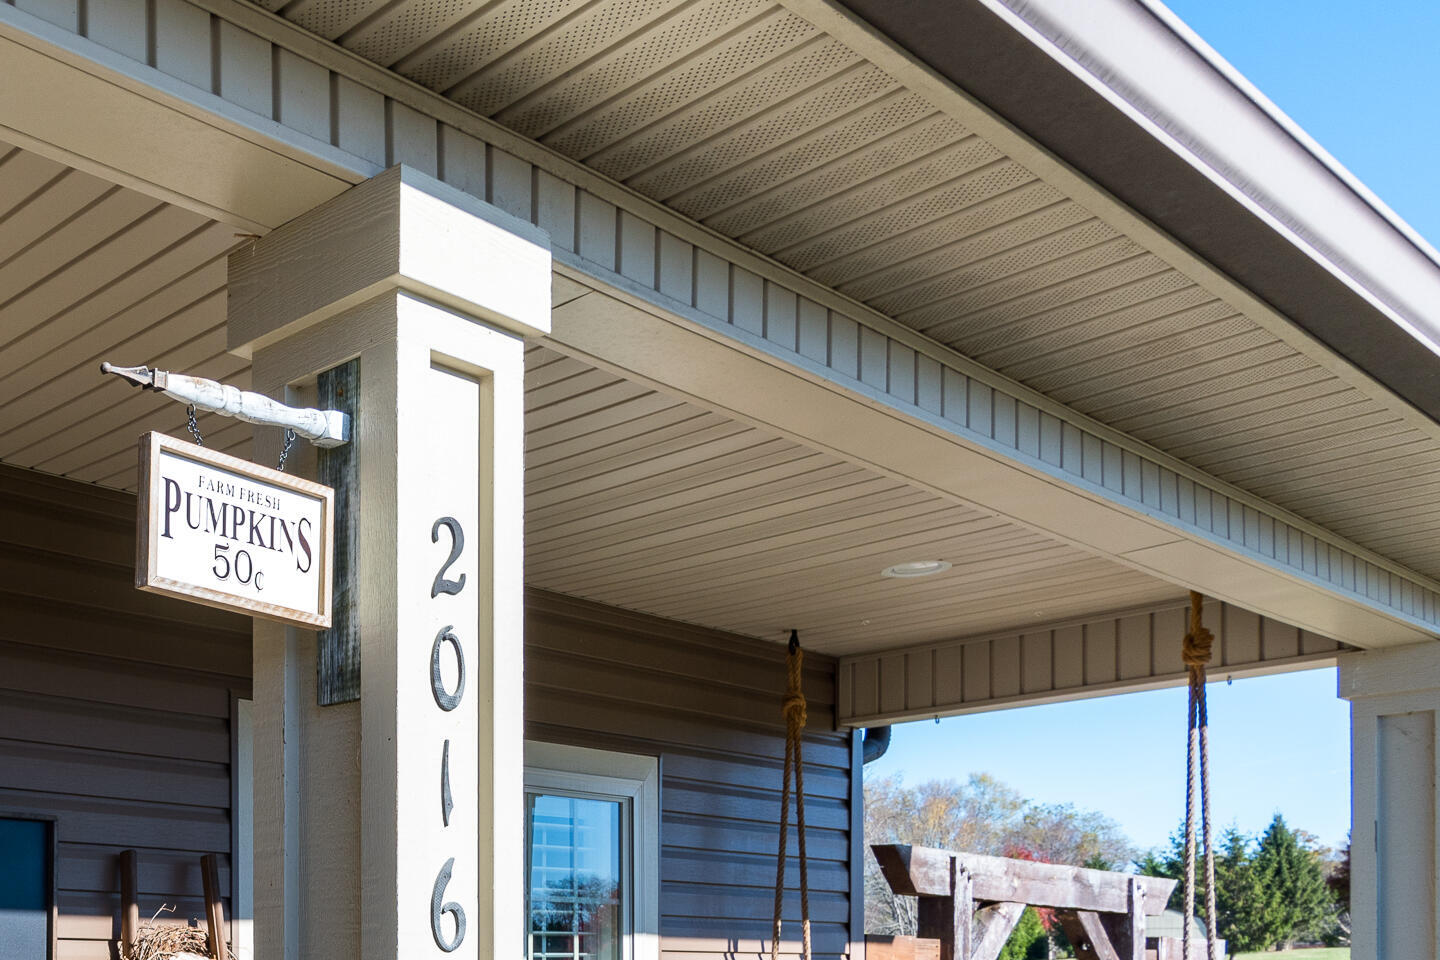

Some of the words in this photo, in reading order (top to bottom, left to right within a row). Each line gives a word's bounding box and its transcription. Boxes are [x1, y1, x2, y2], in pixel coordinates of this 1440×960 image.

[161, 476, 312, 573] PUMPKINS
[198, 475, 235, 498] FARM
[239, 487, 281, 511] FRESH
[430, 516, 467, 953] 2016
